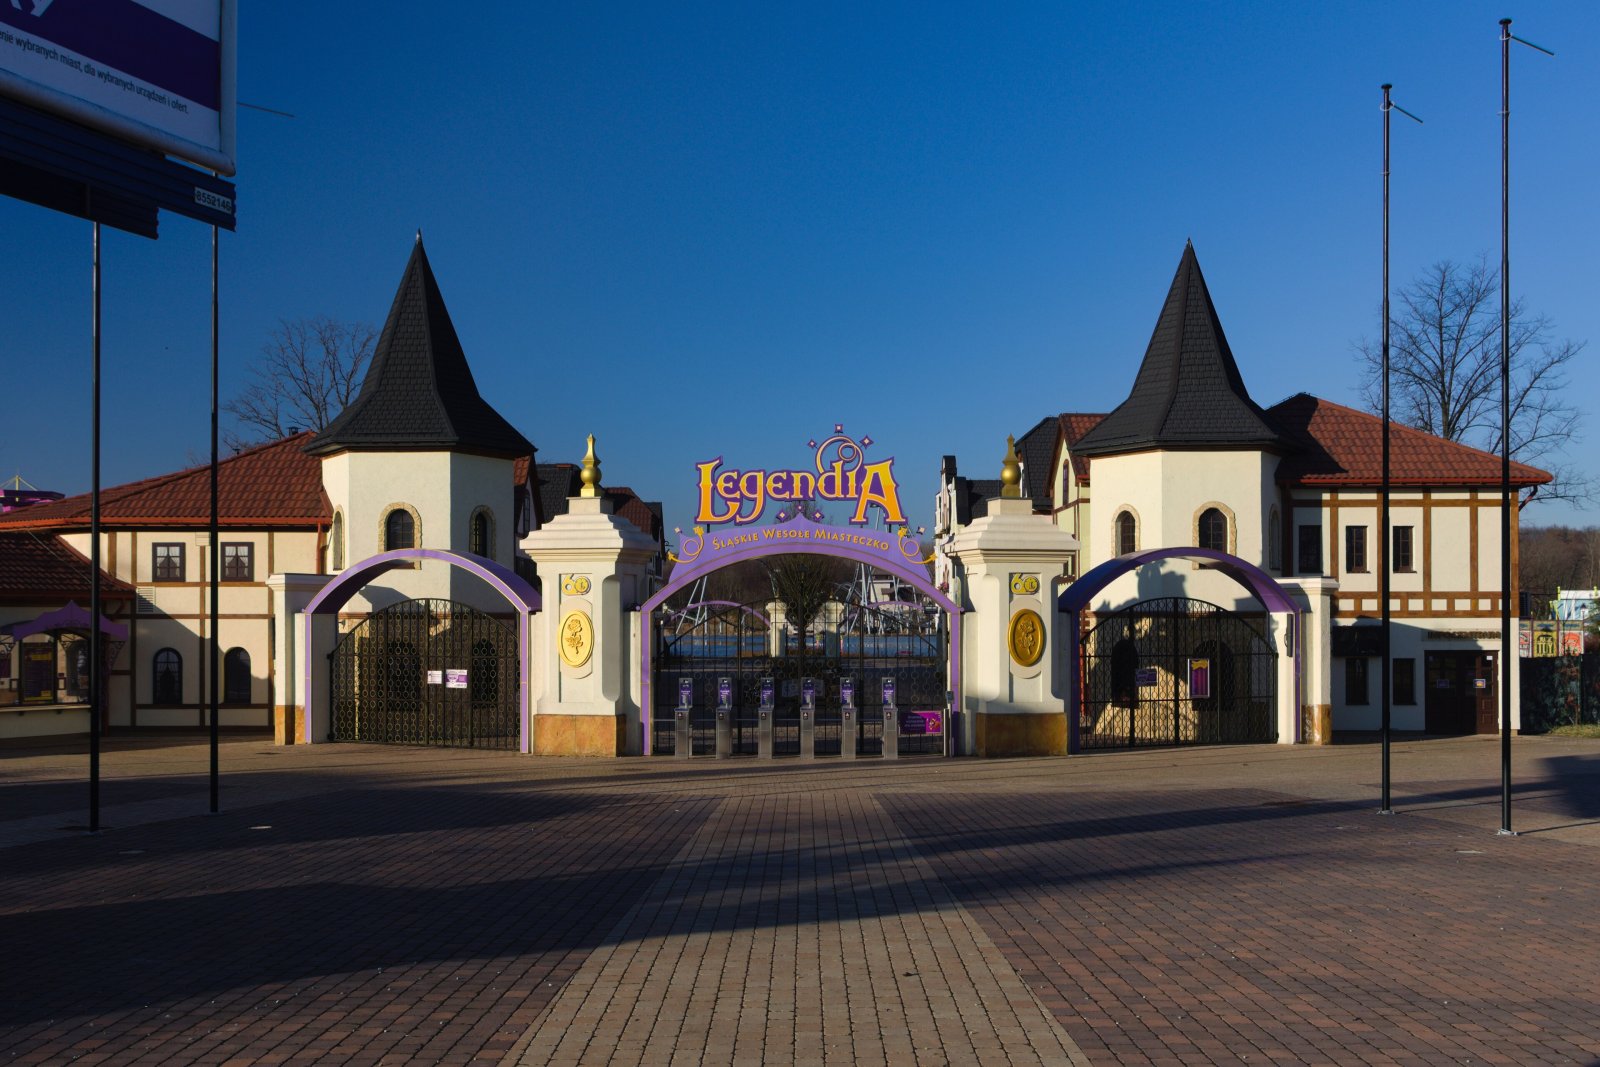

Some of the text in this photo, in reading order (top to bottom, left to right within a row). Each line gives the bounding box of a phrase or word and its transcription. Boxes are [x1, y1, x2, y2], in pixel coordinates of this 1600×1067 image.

[15, 37, 59, 61] wybranych
[60, 54, 83, 73] miast,
[84, 63, 96, 77] dla
[97, 70, 136, 93] wybranych
[171, 98, 189, 114] ofert.
